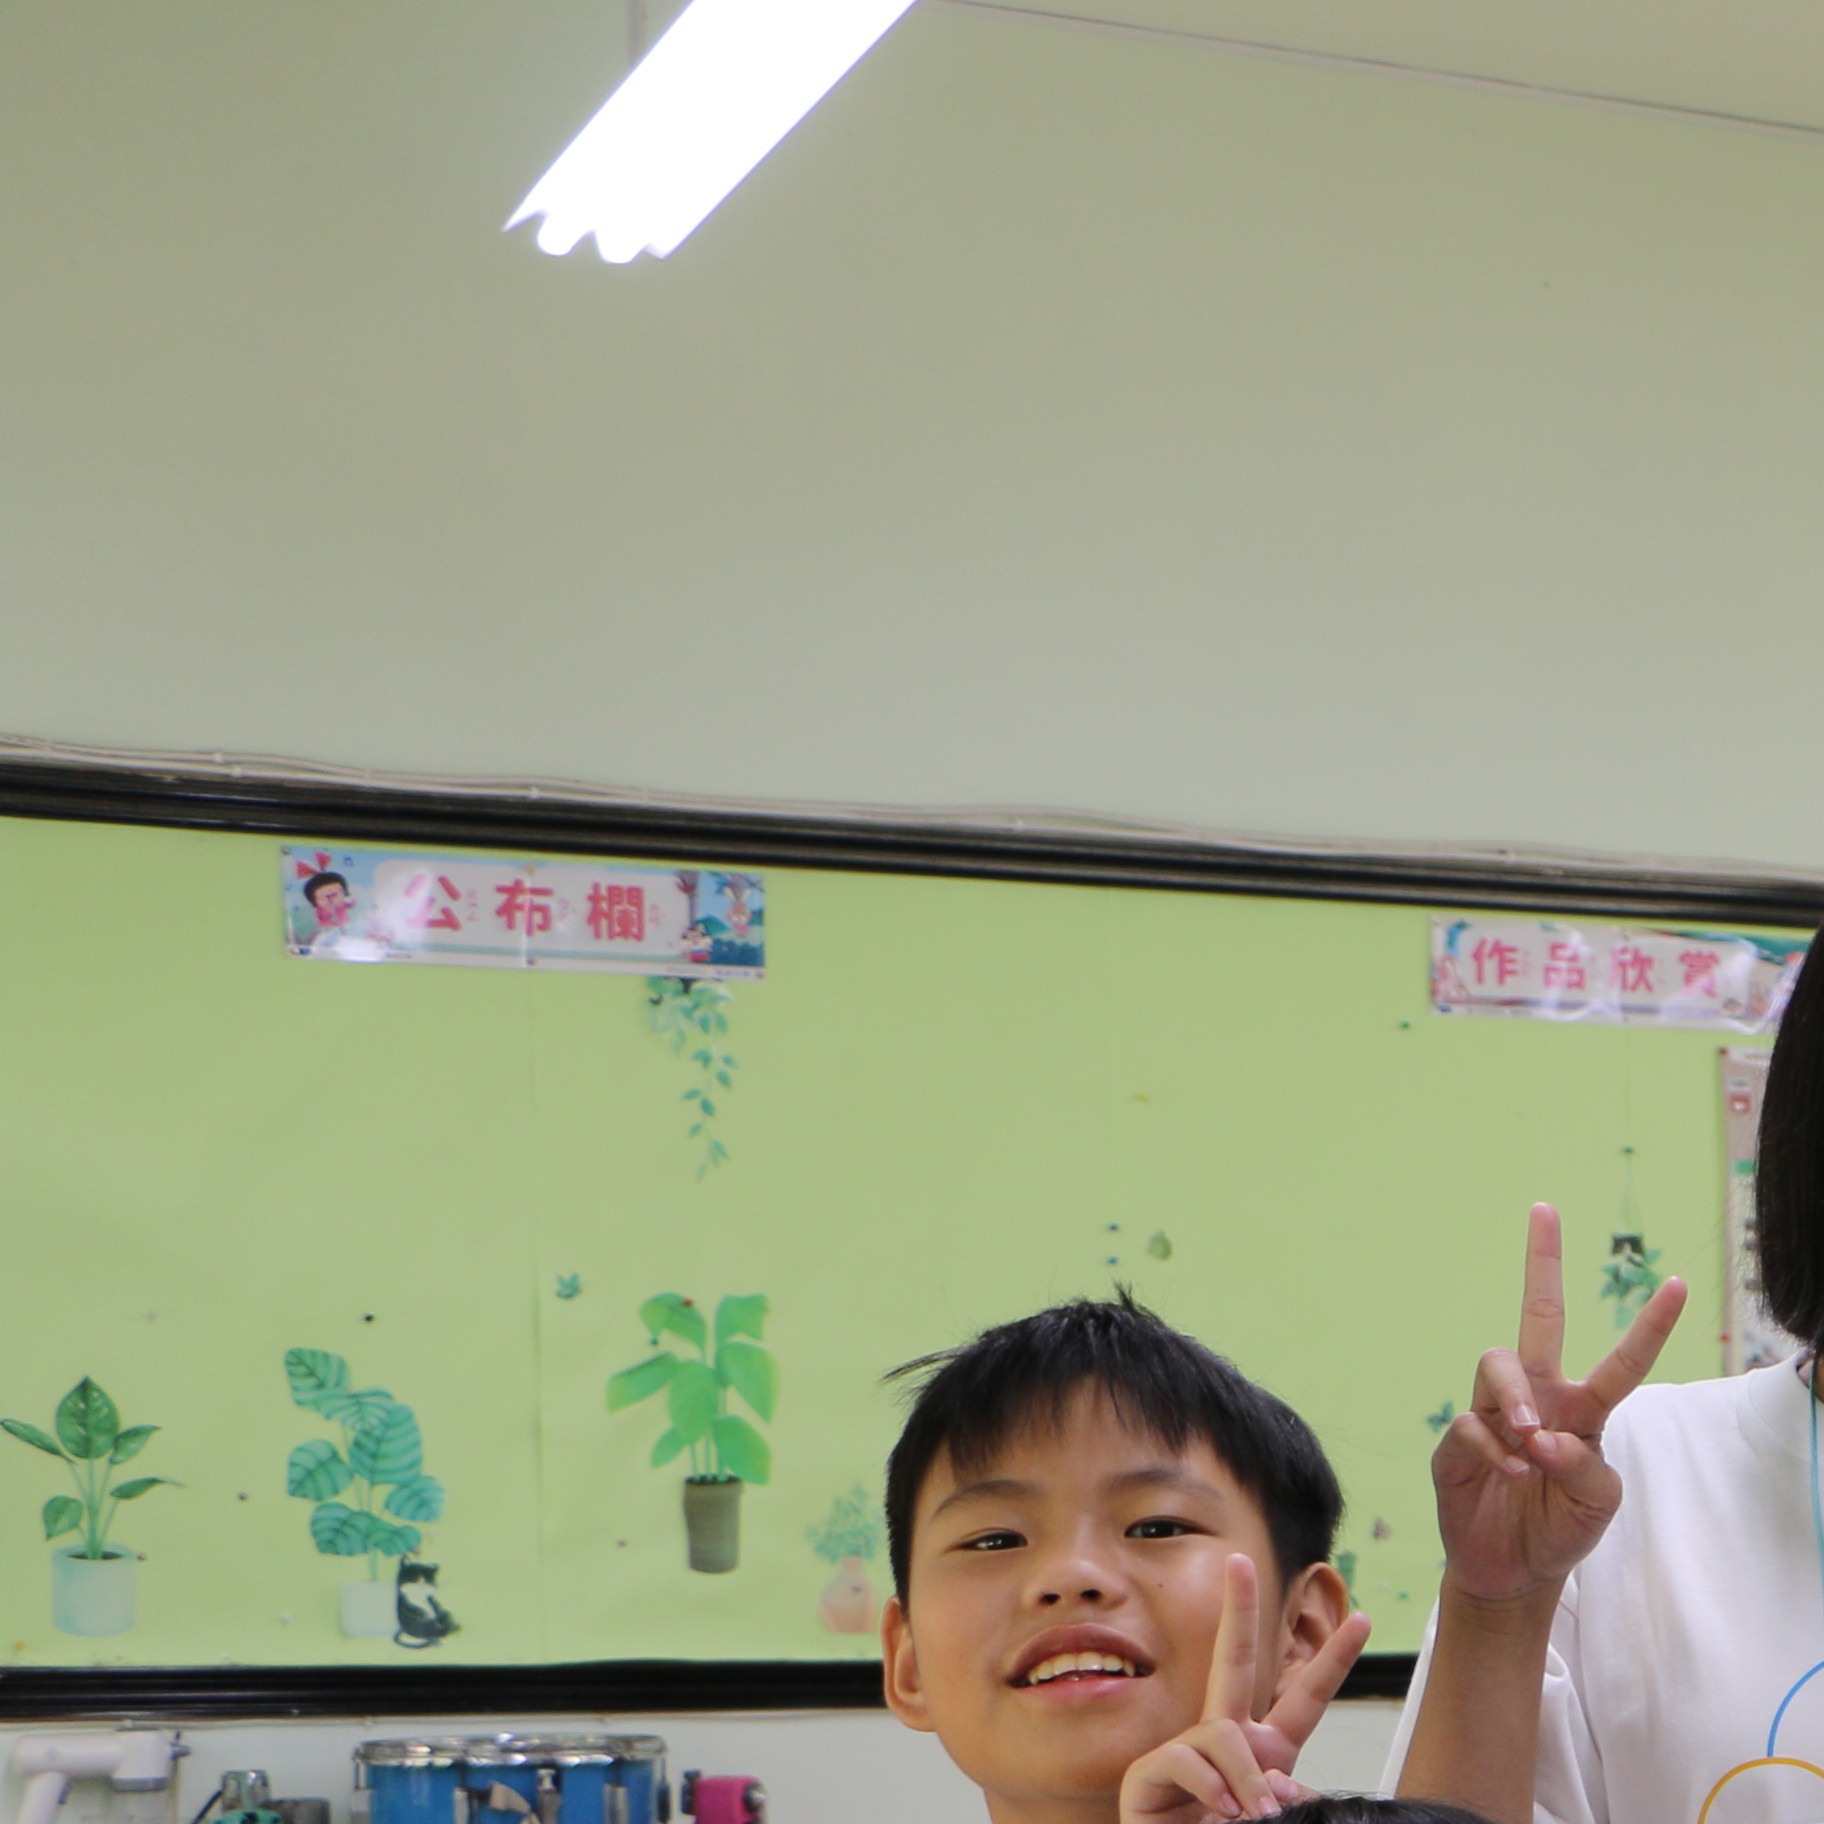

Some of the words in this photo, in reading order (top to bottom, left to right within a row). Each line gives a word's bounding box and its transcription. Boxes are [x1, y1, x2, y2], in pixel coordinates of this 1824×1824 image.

[405, 872, 645, 942] 公布欄
[1471, 937, 1721, 998] 作品欣賞
